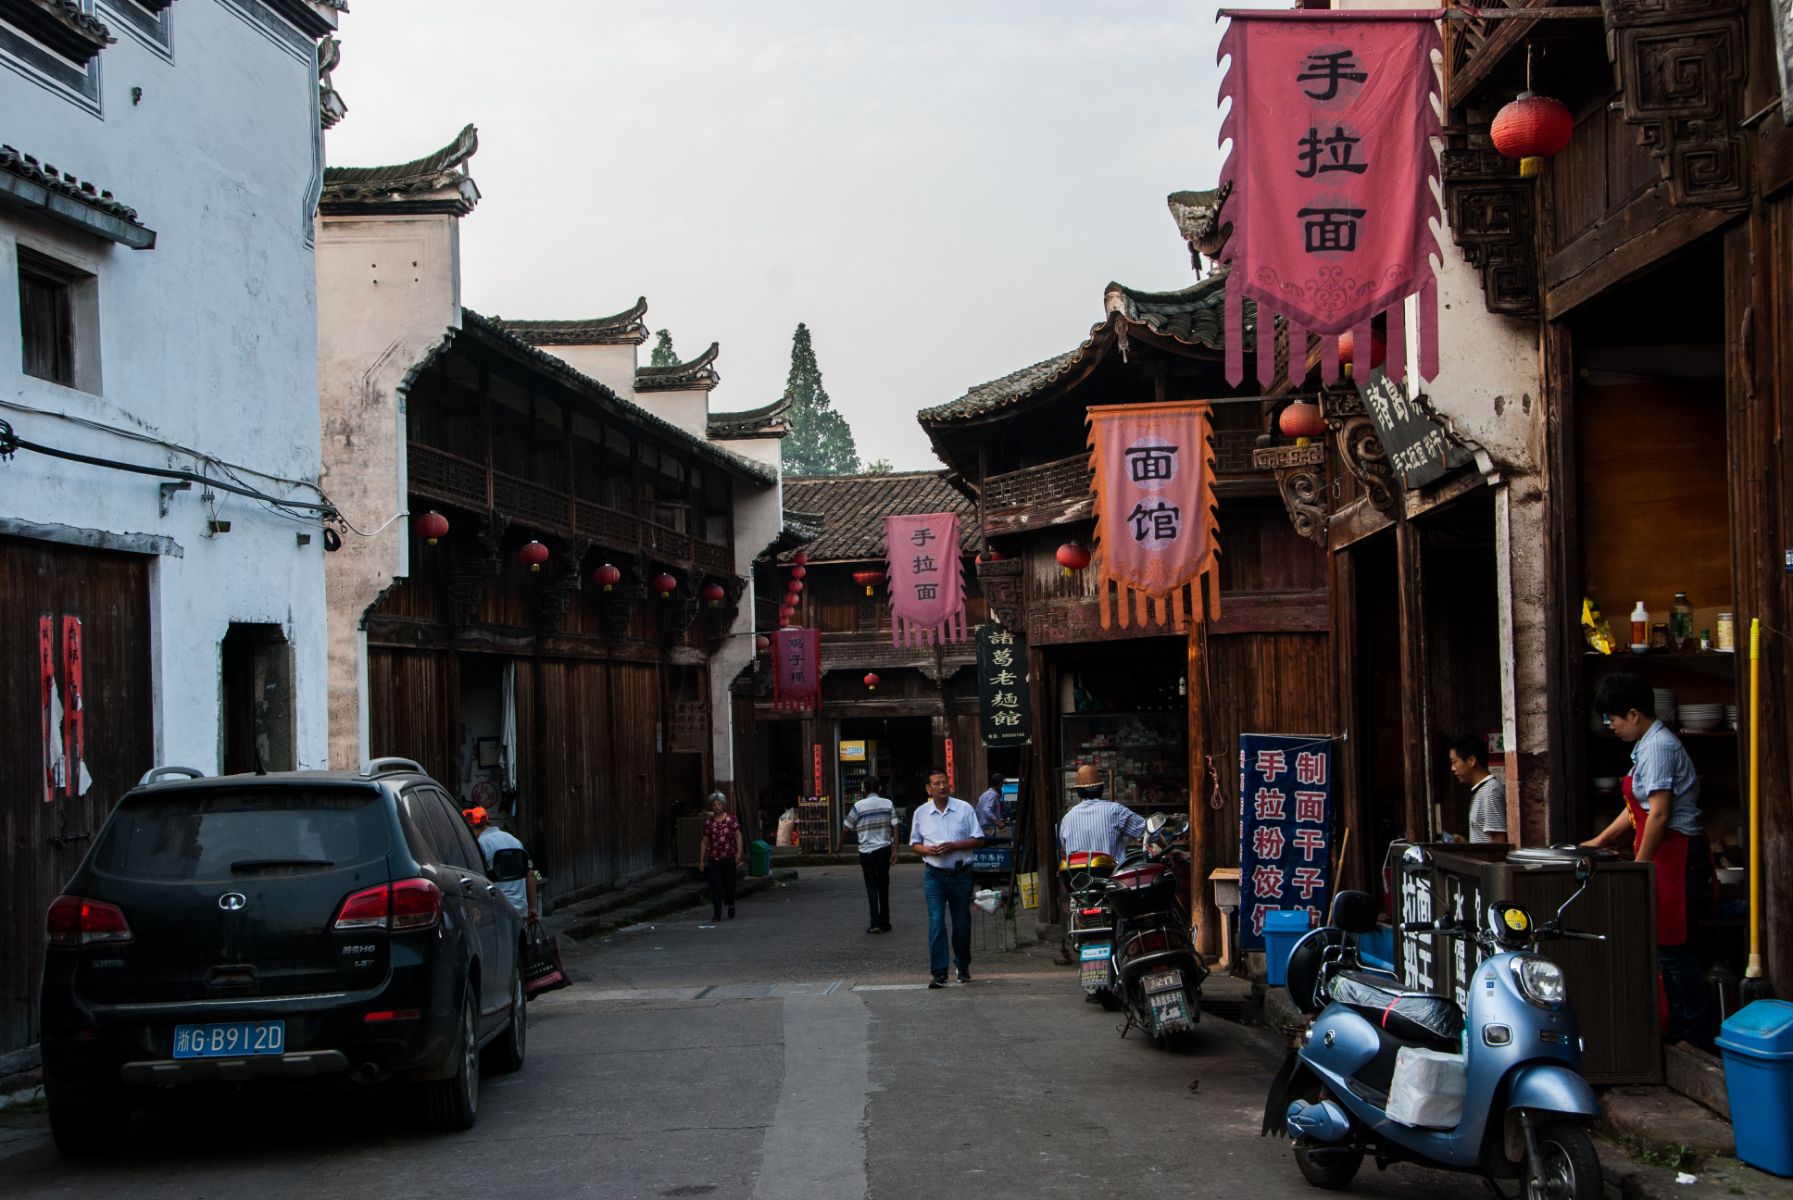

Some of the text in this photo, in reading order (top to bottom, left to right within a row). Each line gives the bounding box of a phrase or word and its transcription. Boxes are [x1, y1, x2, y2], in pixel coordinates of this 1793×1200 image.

[1296, 50, 1368, 253] 手拉面
[1125, 446, 1179, 541] 面馆
[911, 528, 938, 600] 手拉面
[177, 1026, 281, 1052] 浙G·B912D
